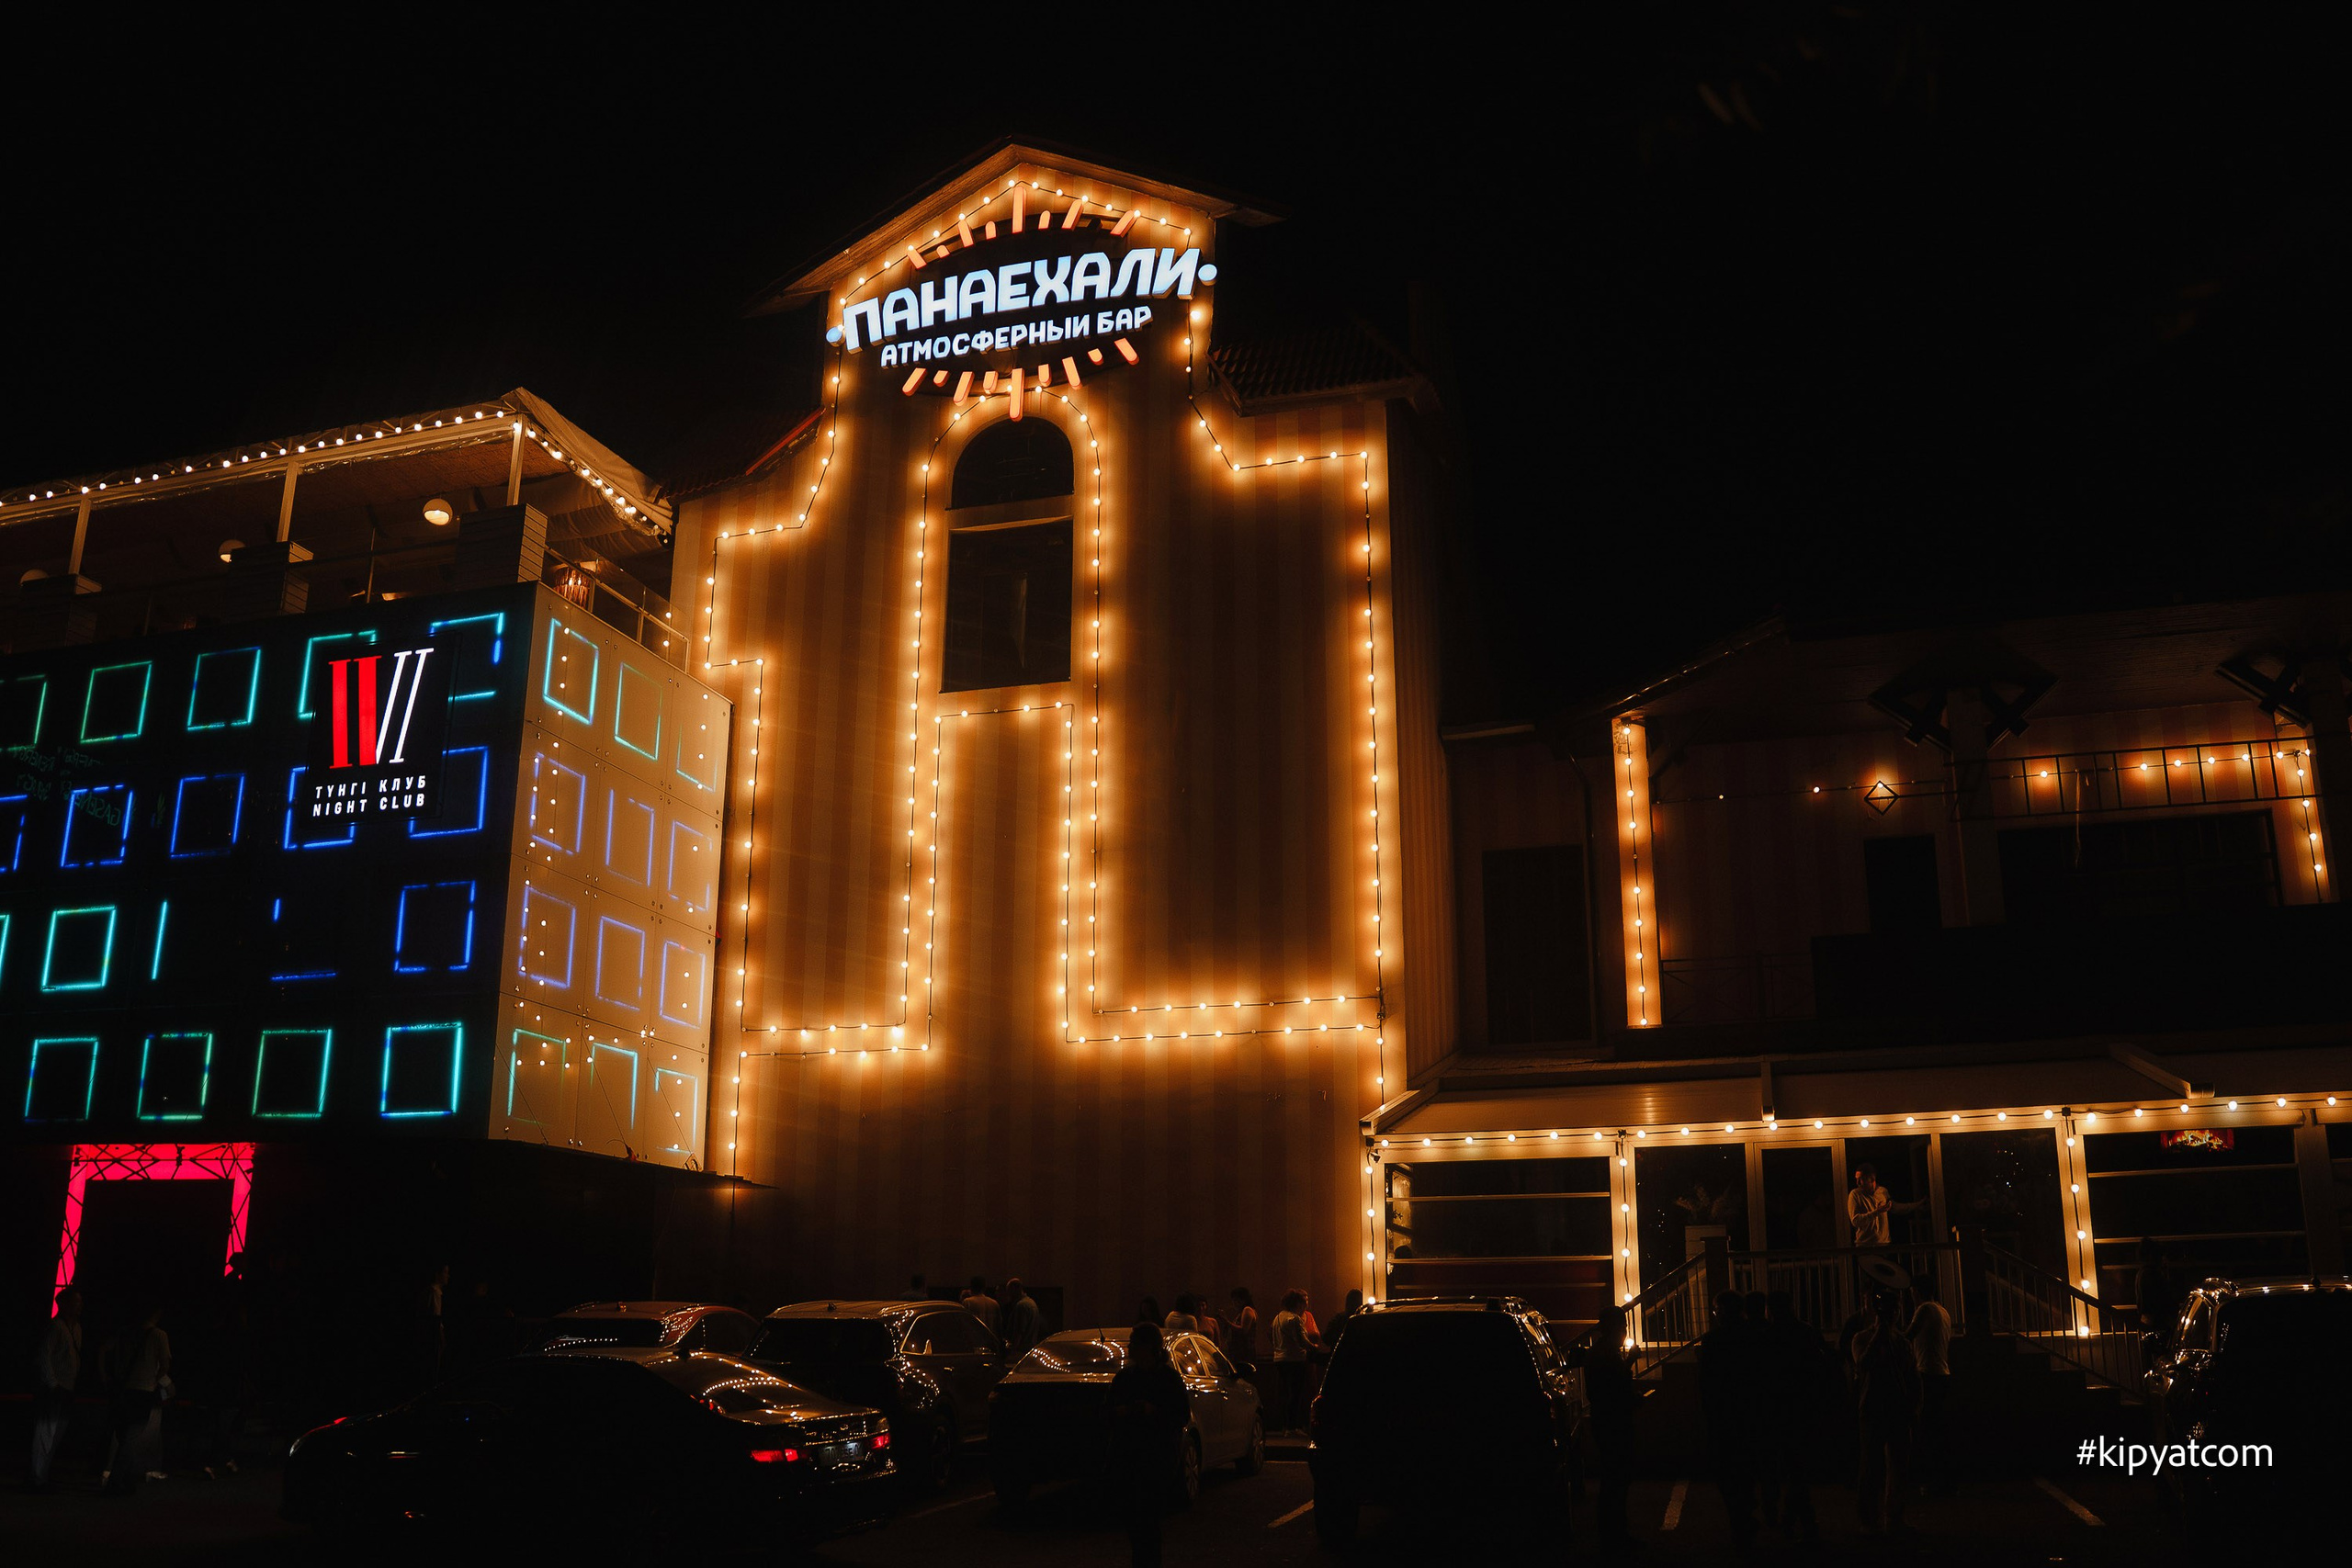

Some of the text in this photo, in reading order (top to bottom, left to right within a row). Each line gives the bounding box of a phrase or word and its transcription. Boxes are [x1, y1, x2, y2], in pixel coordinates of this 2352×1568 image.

[842, 247, 1202, 354] ПАНАЕХАЛИ
[1096, 305, 1152, 334] БАР
[379, 775, 426, 793] КЛУБ
[312, 794, 424, 817] NIGHT CLUB
